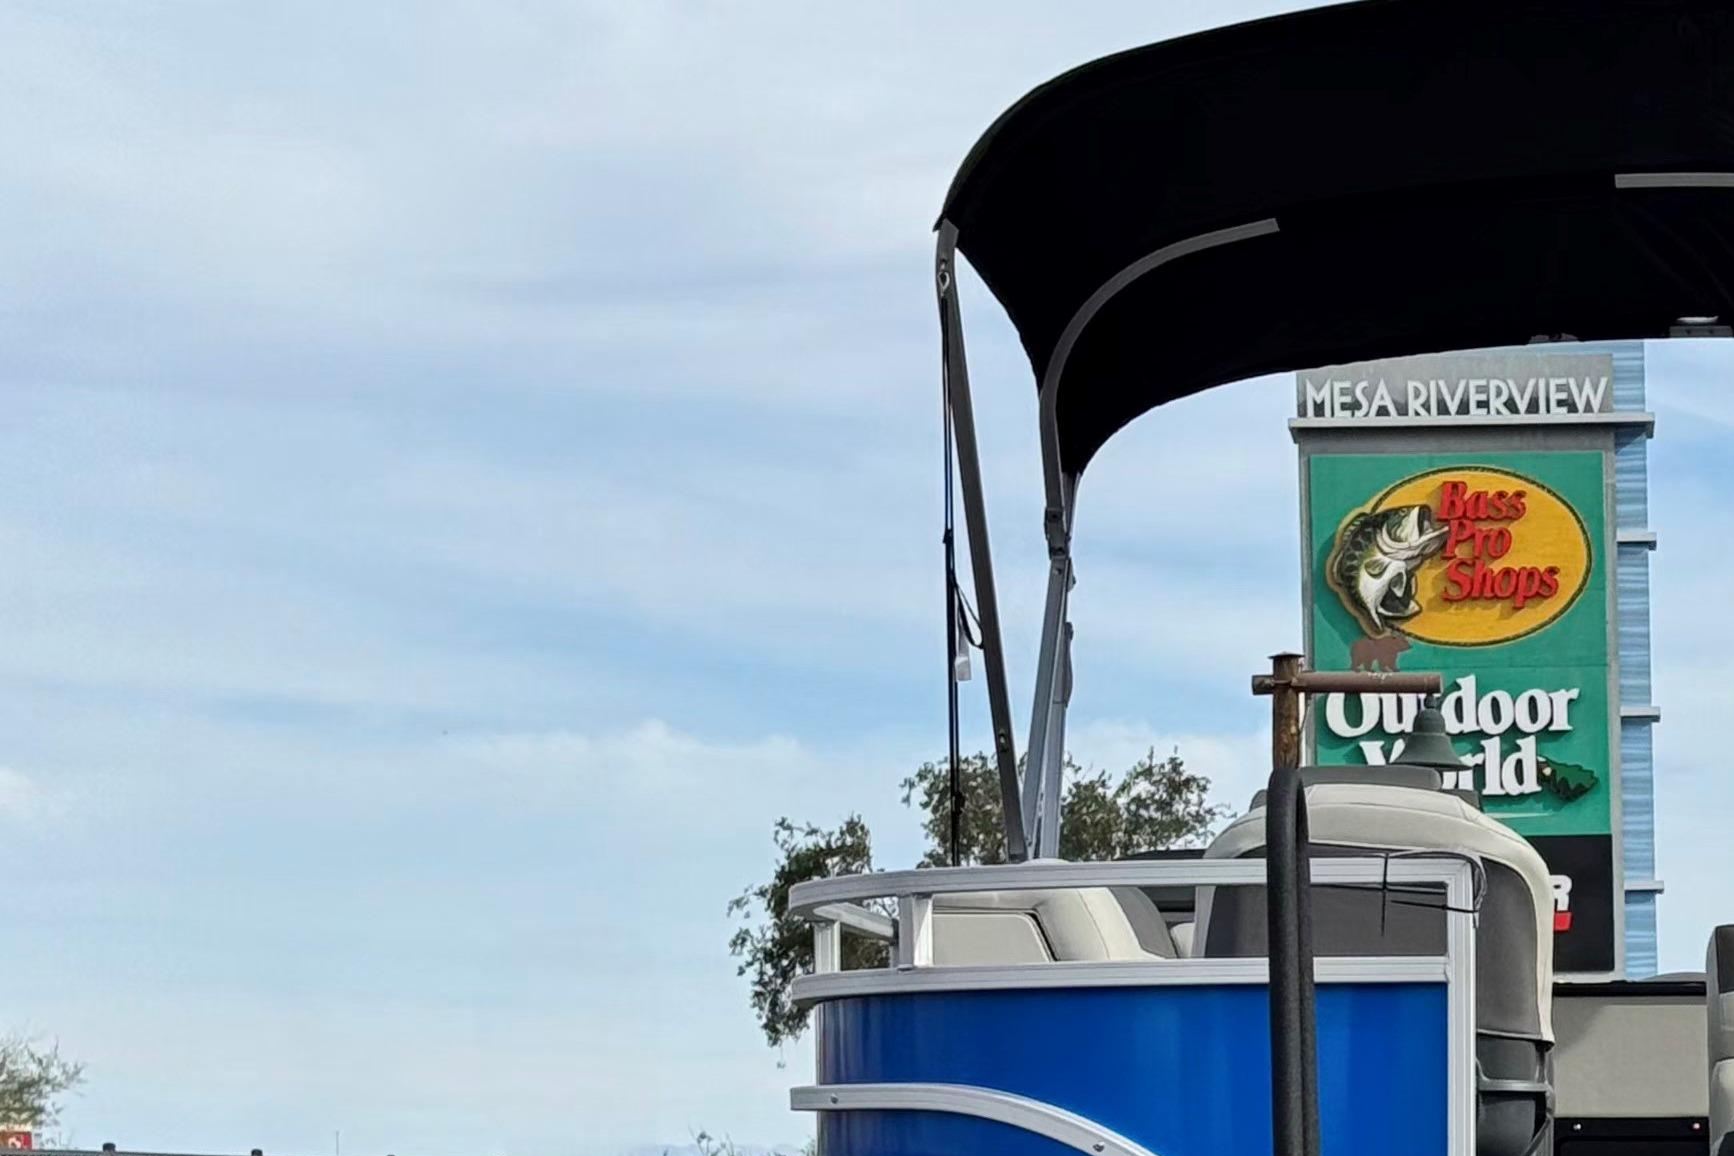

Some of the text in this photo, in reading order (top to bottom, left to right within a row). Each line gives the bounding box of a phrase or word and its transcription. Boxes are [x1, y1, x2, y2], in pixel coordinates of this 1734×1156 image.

[1305, 376, 1609, 418] MESA RIVERVIEW
[1437, 480, 1528, 521] Bass
[1440, 519, 1513, 560] Pro
[1442, 557, 1561, 610] Shops
[1325, 674, 1580, 738] Oudoor
[1358, 734, 1543, 796] rld
